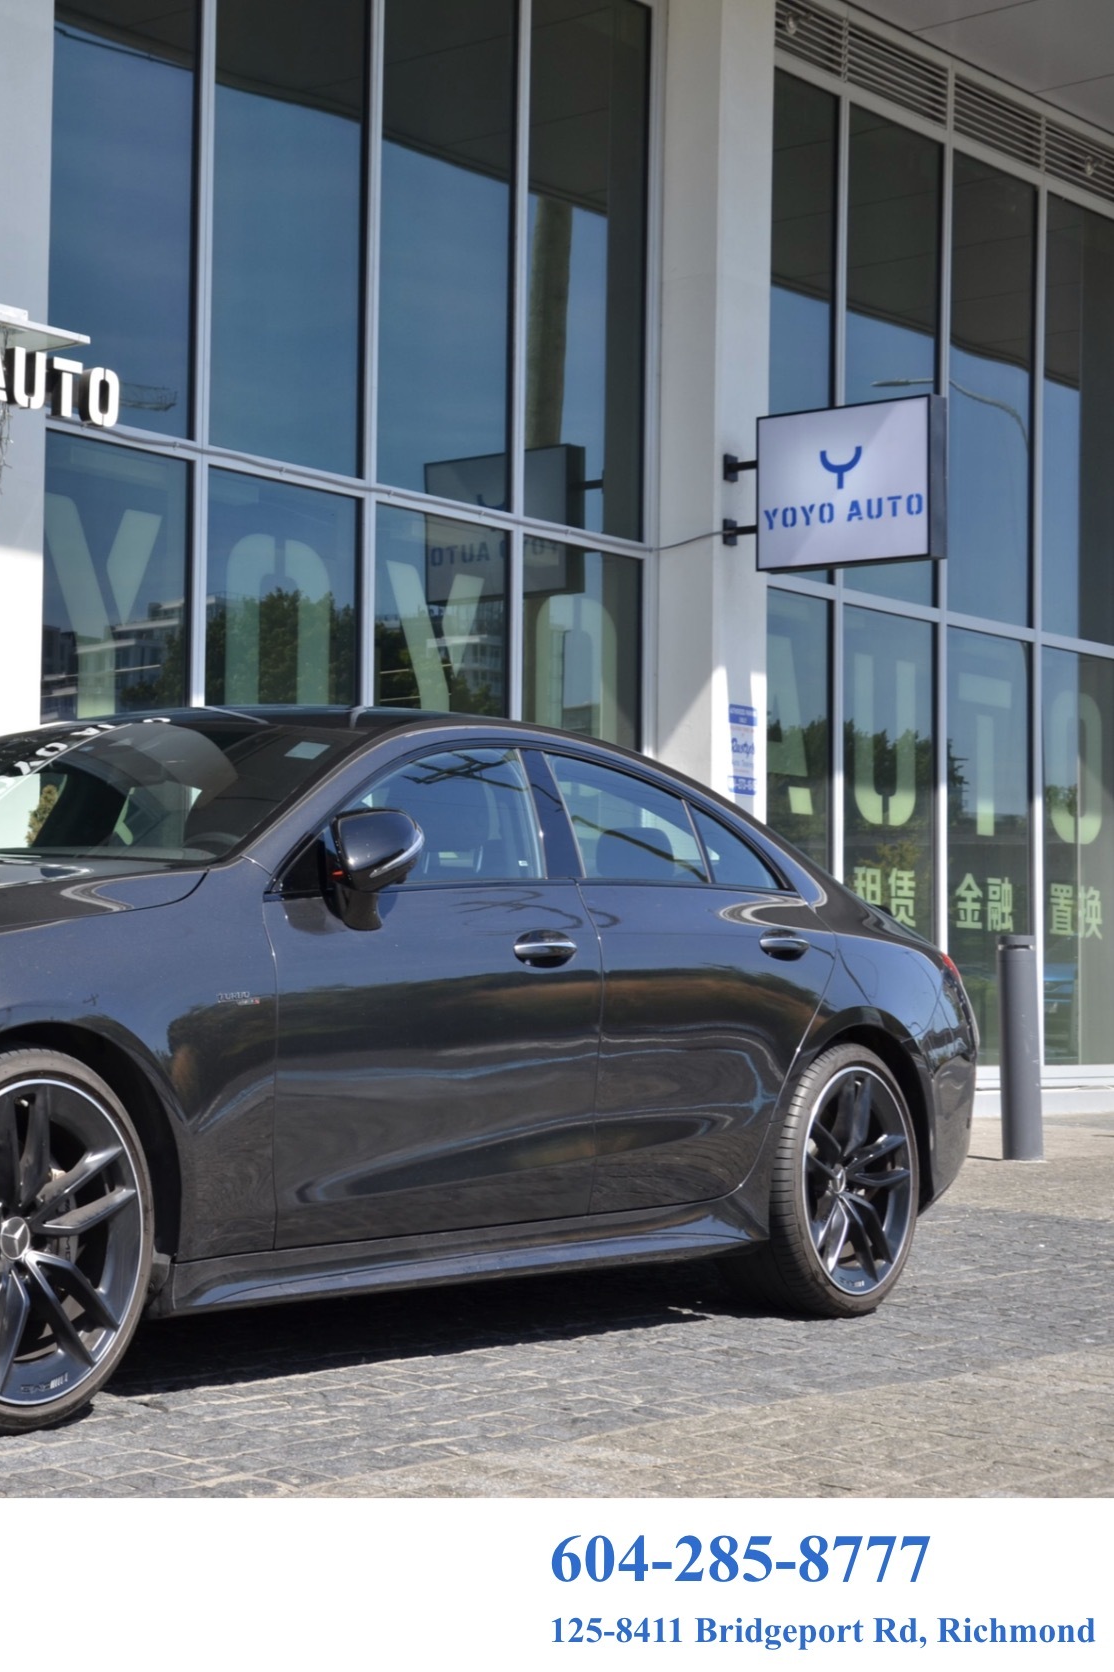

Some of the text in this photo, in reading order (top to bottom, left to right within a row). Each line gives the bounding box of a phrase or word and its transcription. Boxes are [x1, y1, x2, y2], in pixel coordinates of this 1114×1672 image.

[764, 493, 924, 531] YOYO AUTO
[955, 872, 1014, 933] 金融
[1049, 882, 1103, 940] 置换
